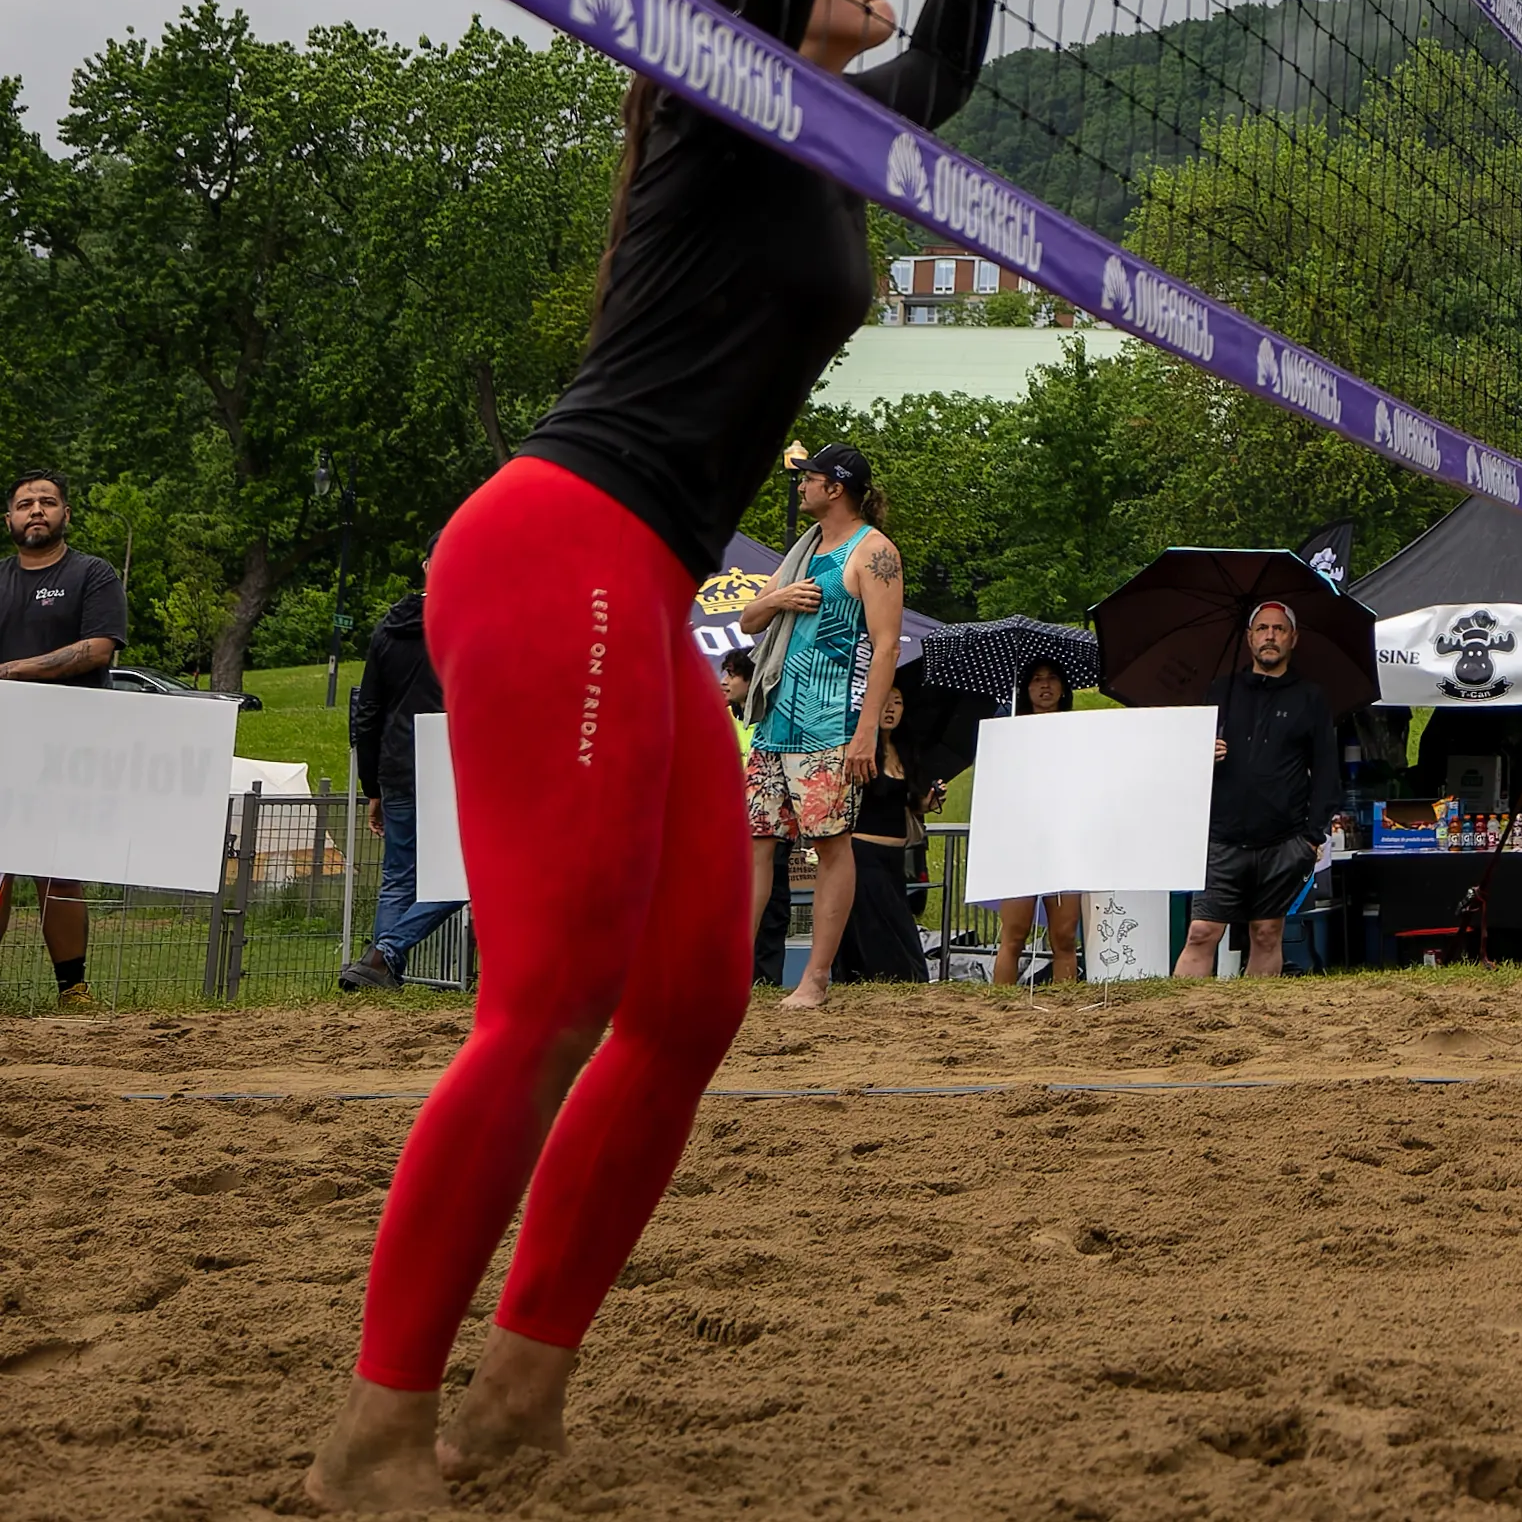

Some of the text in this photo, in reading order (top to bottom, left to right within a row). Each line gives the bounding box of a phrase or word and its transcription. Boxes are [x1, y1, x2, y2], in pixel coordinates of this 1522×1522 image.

[932, 154, 1042, 274] OVERKILL
[1134, 271, 1213, 362] OVERKILL
[577, 588, 609, 767] LEFT ON FRIDAY
[1459, 689, 1491, 699] T-Can
